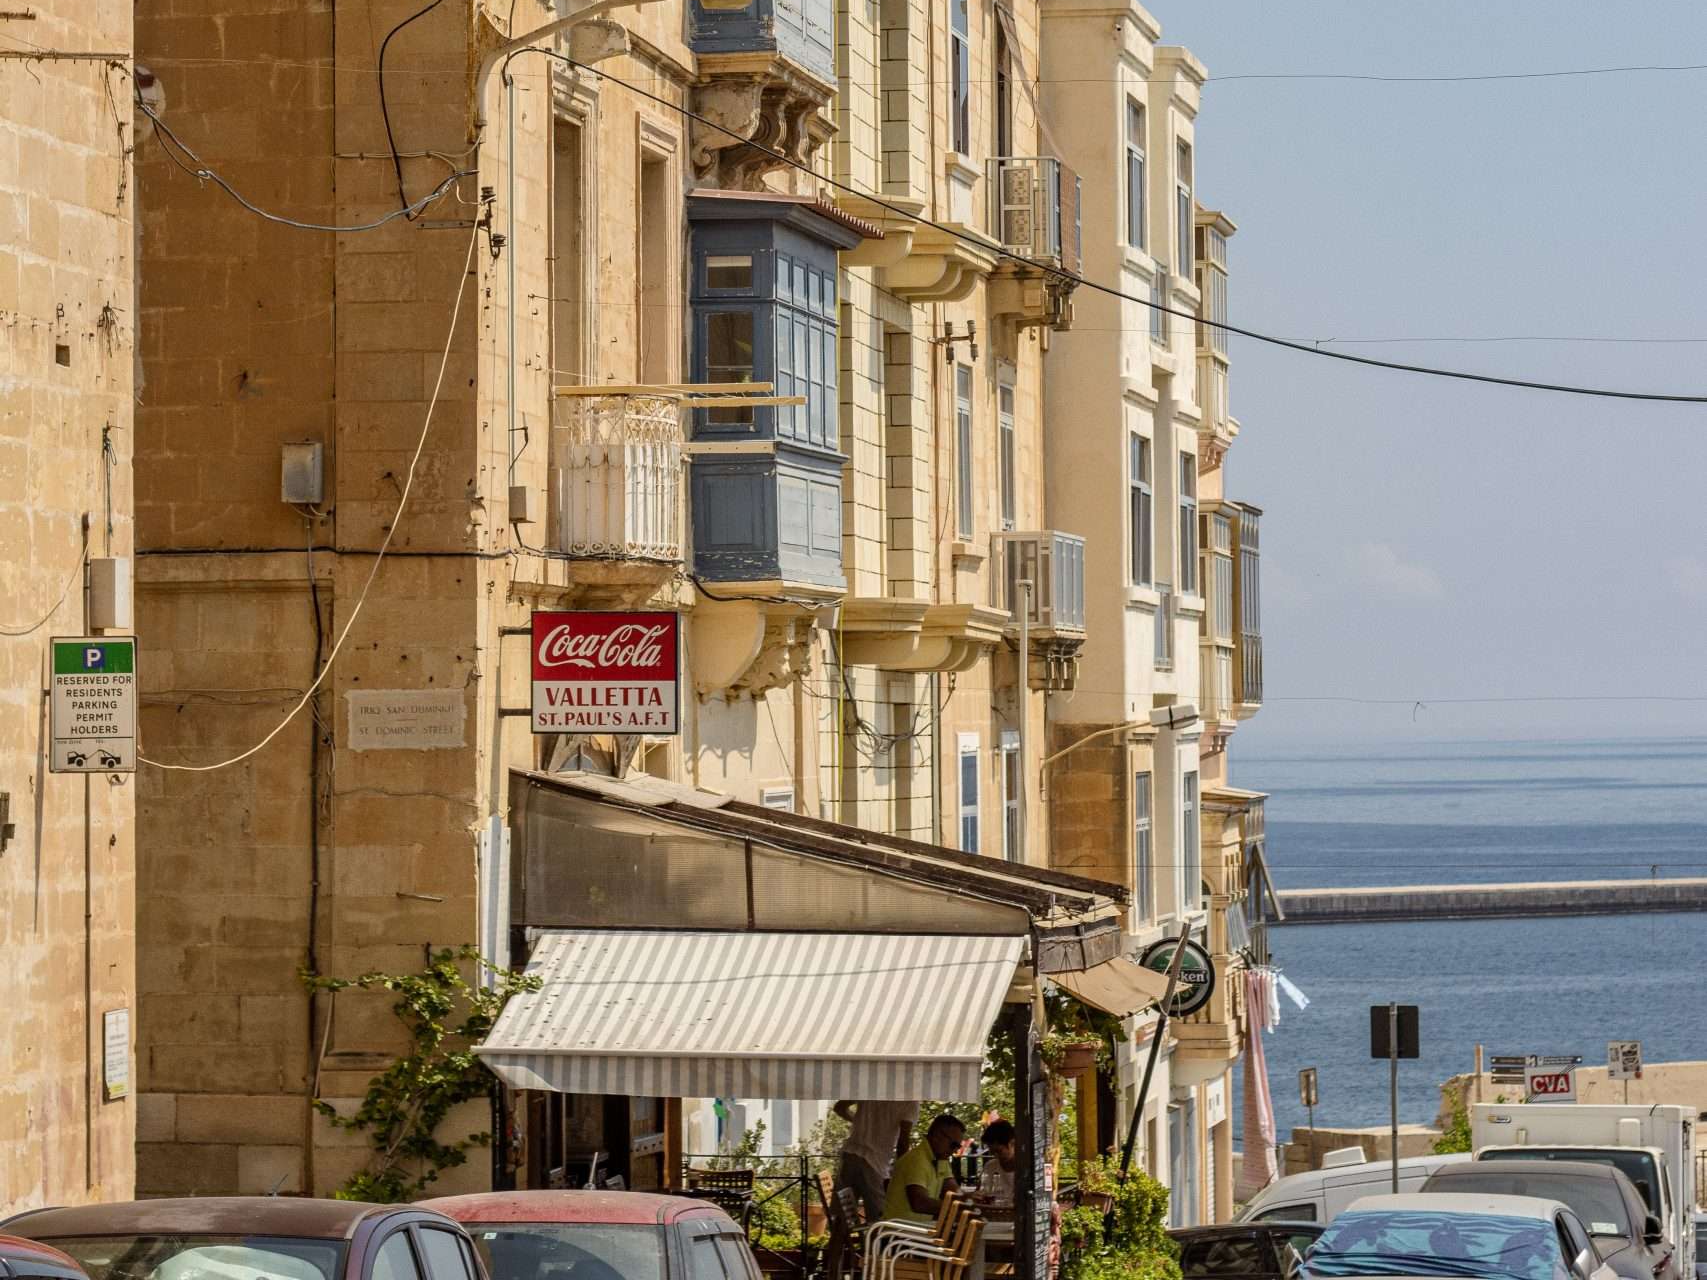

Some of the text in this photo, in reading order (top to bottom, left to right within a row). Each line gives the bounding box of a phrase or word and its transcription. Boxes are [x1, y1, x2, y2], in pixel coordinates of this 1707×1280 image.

[538, 624, 670, 668] Coca-Cola
[87, 648, 101, 668] P
[56, 675, 132, 686] RESERVED FOR
[66, 688, 122, 697] RESIDENTS
[545, 687, 663, 706] VALLETTA
[72, 700, 117, 710] PARKING
[76, 713, 113, 722] PERMIT
[538, 712, 669, 726] ST.PAUL'S A.F.T
[70, 725, 118, 735] HOLDERS
[1532, 1076, 1569, 1093] CVA
